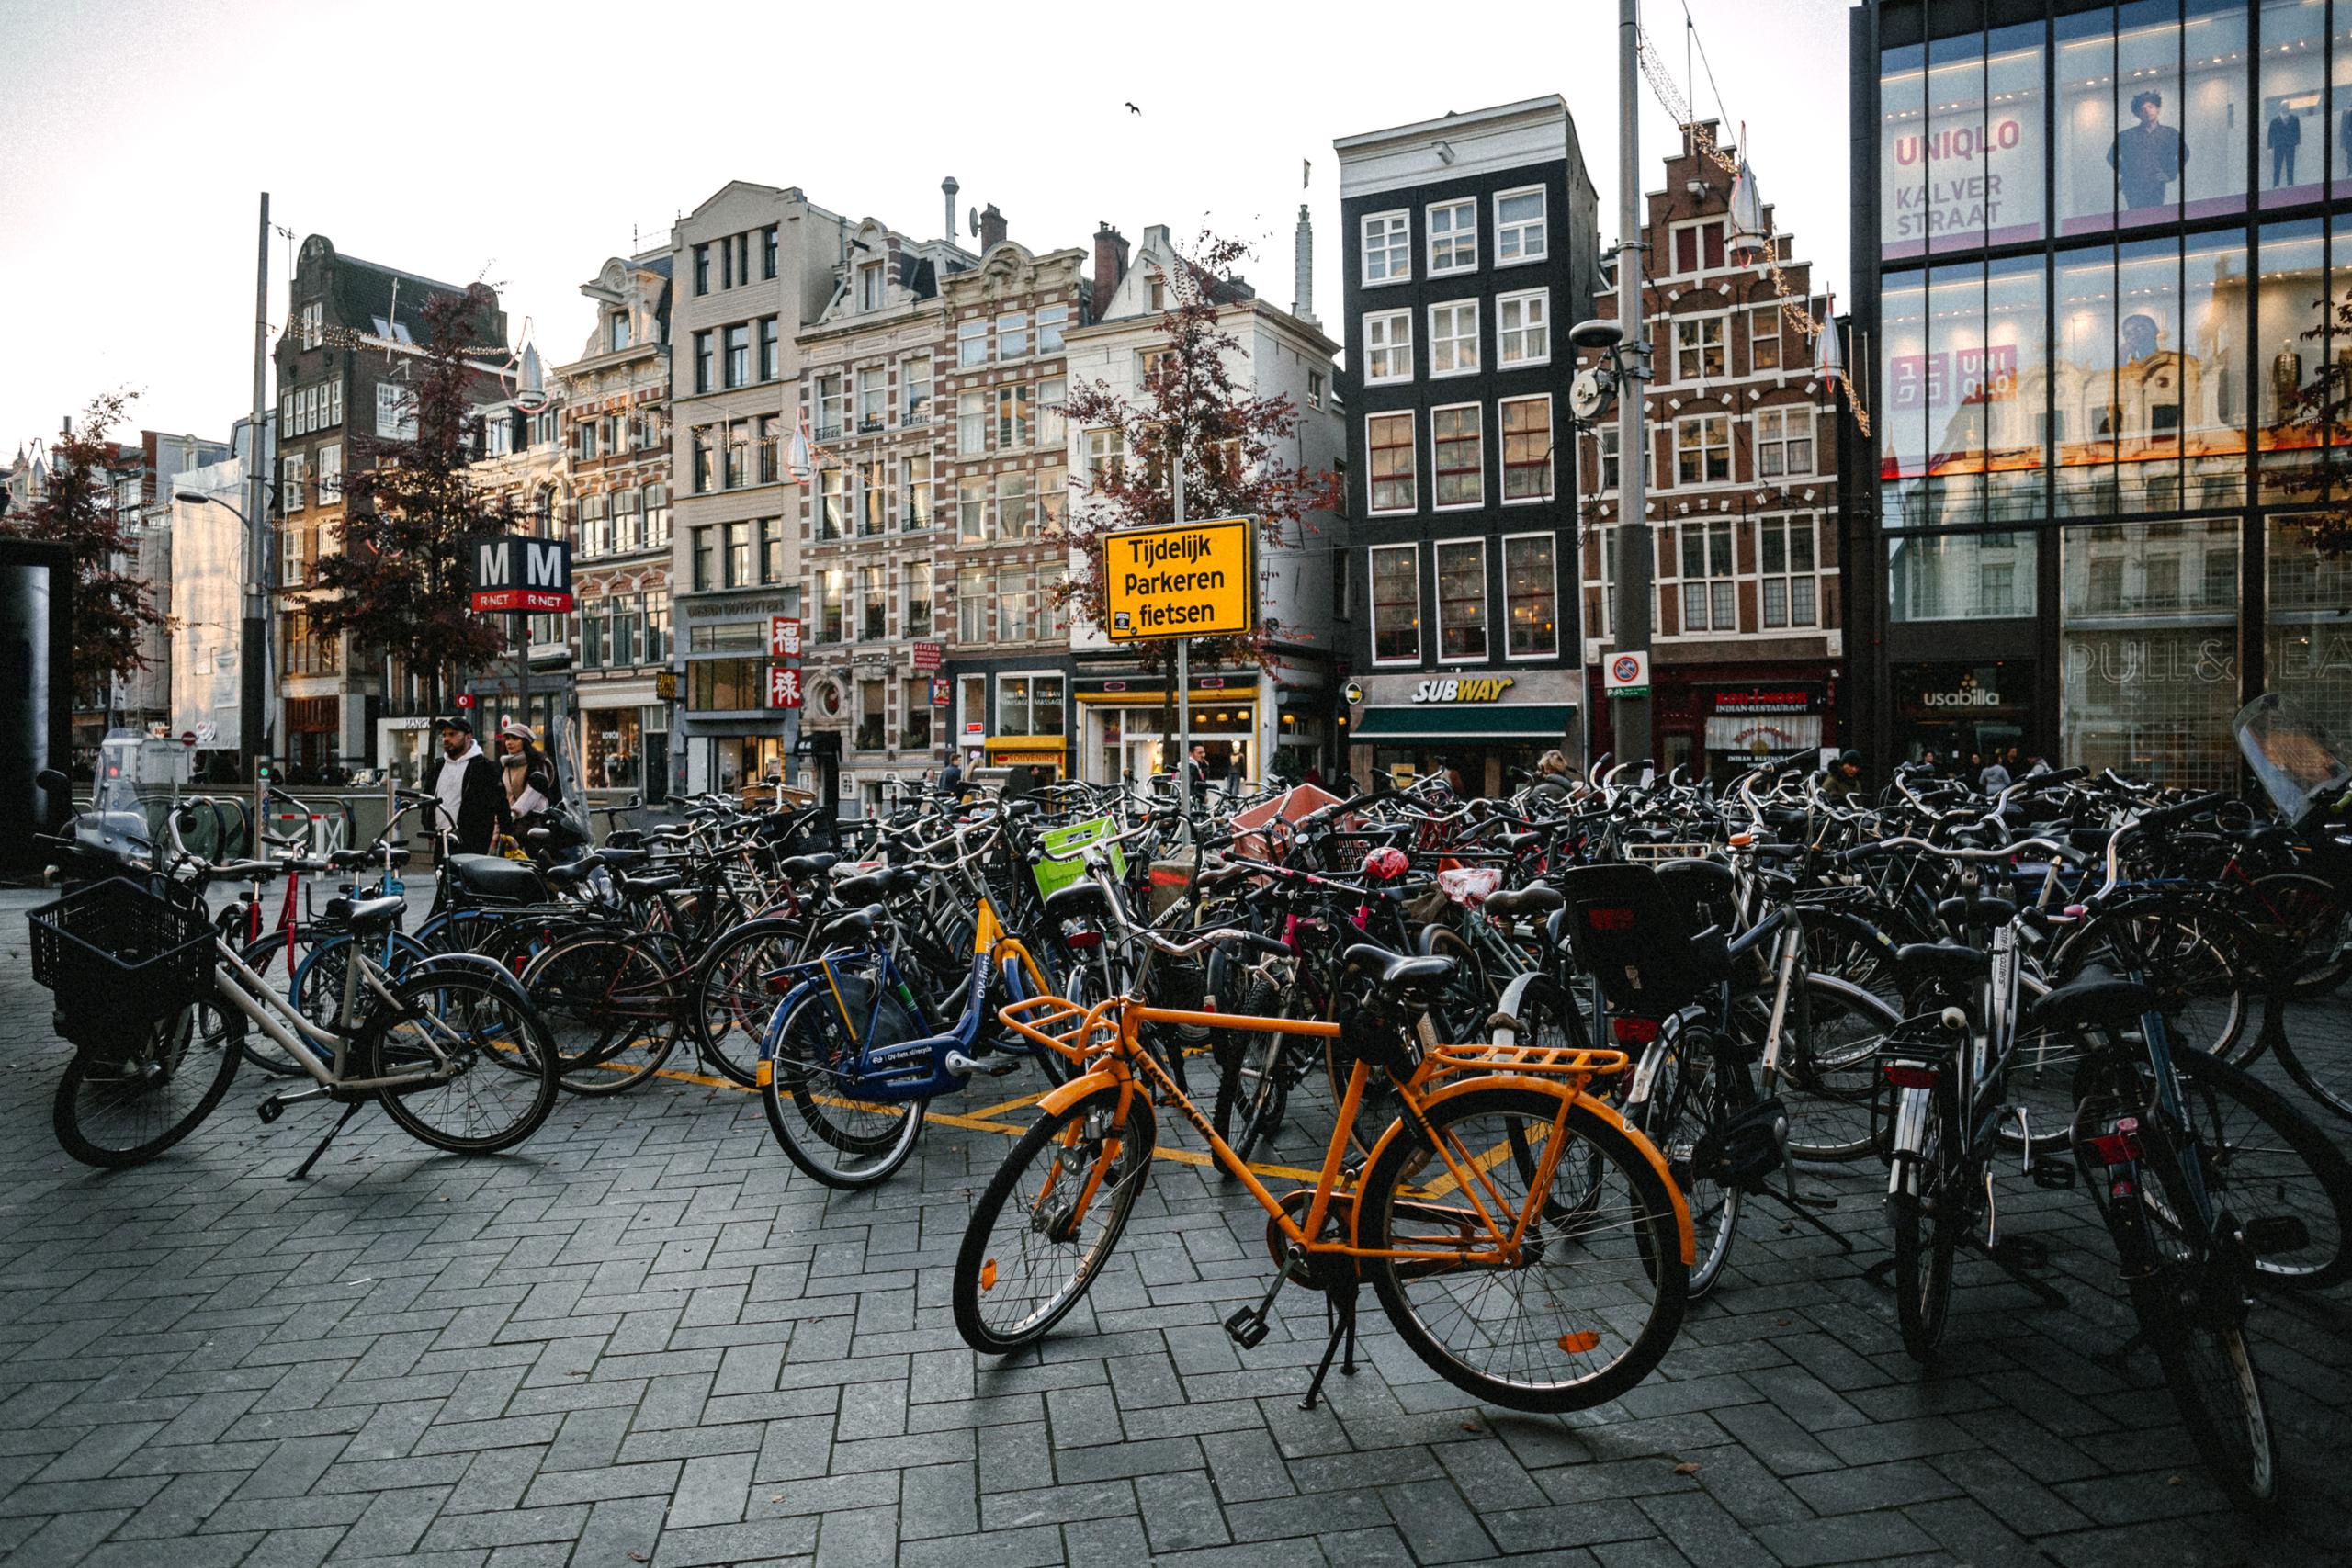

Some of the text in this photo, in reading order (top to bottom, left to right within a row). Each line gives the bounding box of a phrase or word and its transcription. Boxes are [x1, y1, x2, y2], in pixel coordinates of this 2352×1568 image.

[1896, 120, 2020, 166] UNIQLO
[1897, 175, 2002, 209] KALVER
[1898, 201, 2002, 236] STRAAT
[480, 543, 509, 587] M
[527, 542, 562, 588] M
[1128, 534, 1212, 569] Tijdelijk
[1125, 570, 1225, 597] Parkeren
[1139, 604, 1215, 627] fietsen
[774, 621, 799, 654] 福
[1034, 698, 1063, 706] MASSAGE
[1411, 676, 1514, 703] SUBWAY
[1924, 687, 2000, 706] usabilla
[1009, 752, 1055, 762] SOUVENIRS
